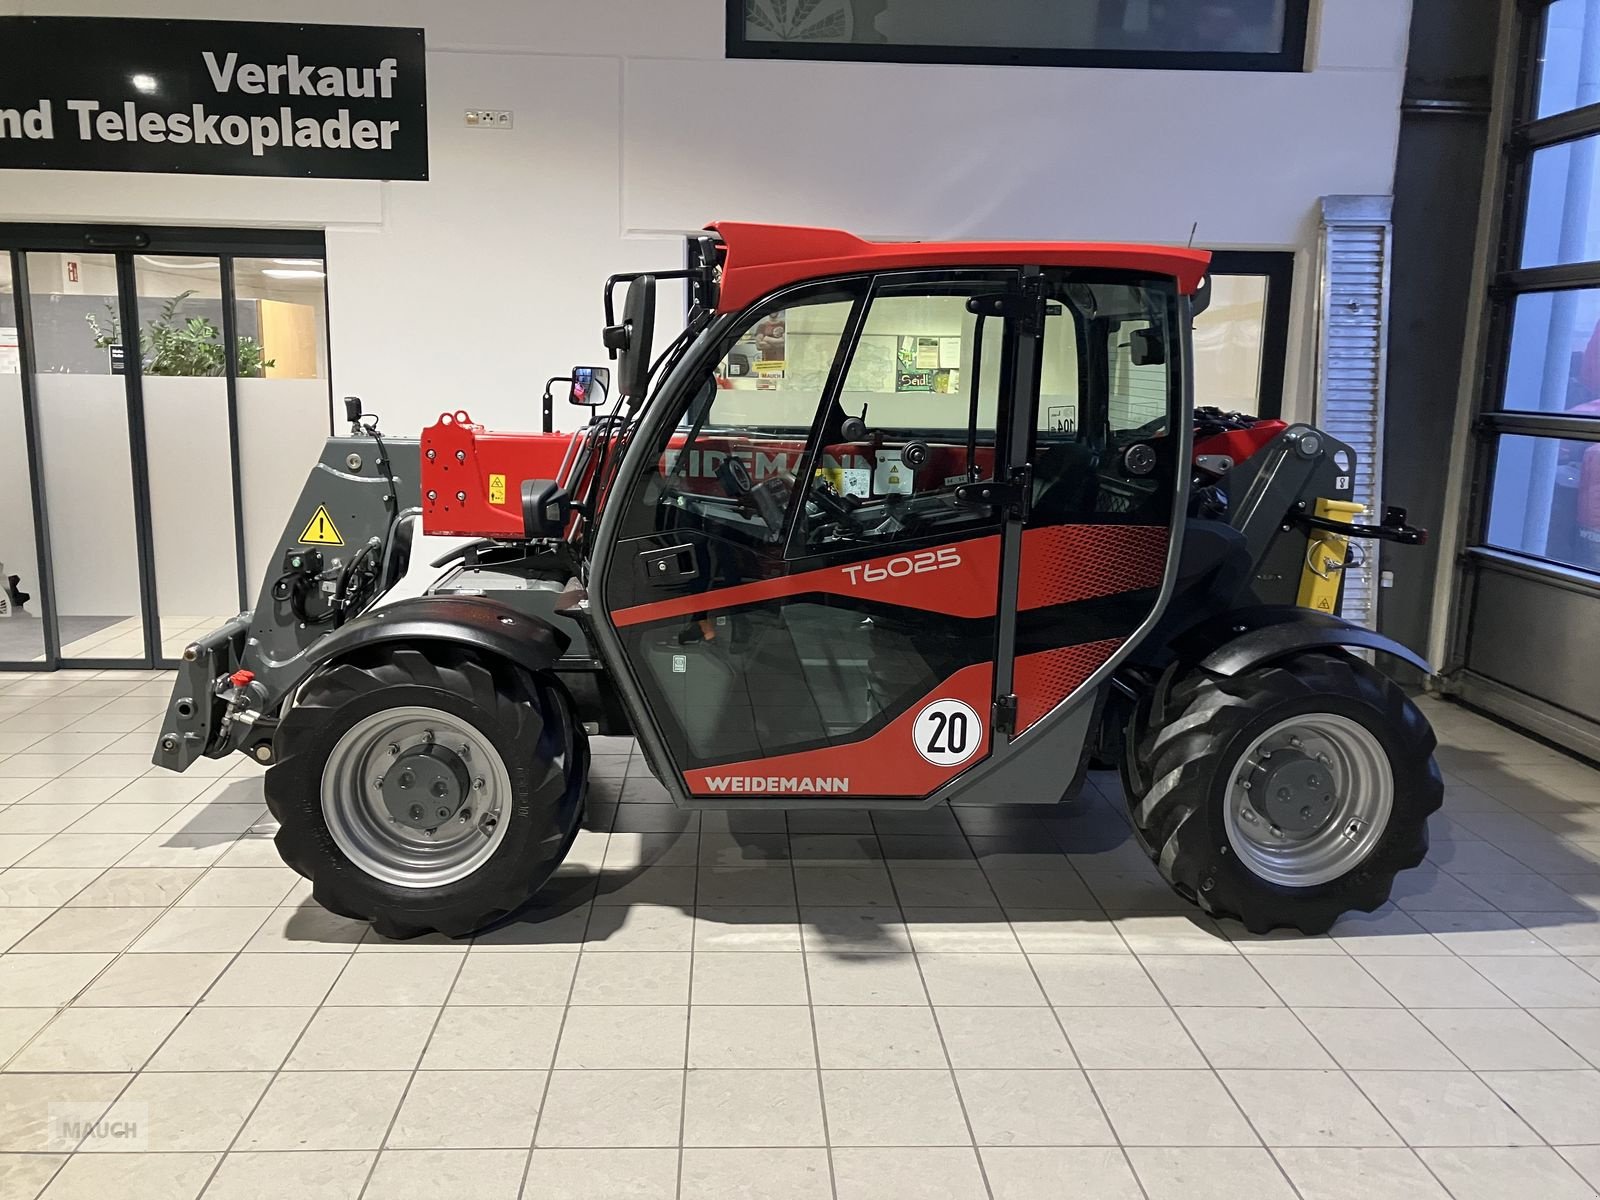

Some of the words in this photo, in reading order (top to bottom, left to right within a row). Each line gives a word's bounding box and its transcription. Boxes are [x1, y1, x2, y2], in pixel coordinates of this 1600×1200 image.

[201, 51, 398, 98] Verkauf
[66, 100, 399, 157] Teleskoplader
[841, 547, 962, 585] T6025
[926, 711, 968, 754] 20
[704, 776, 849, 793] WEIDEMANN
